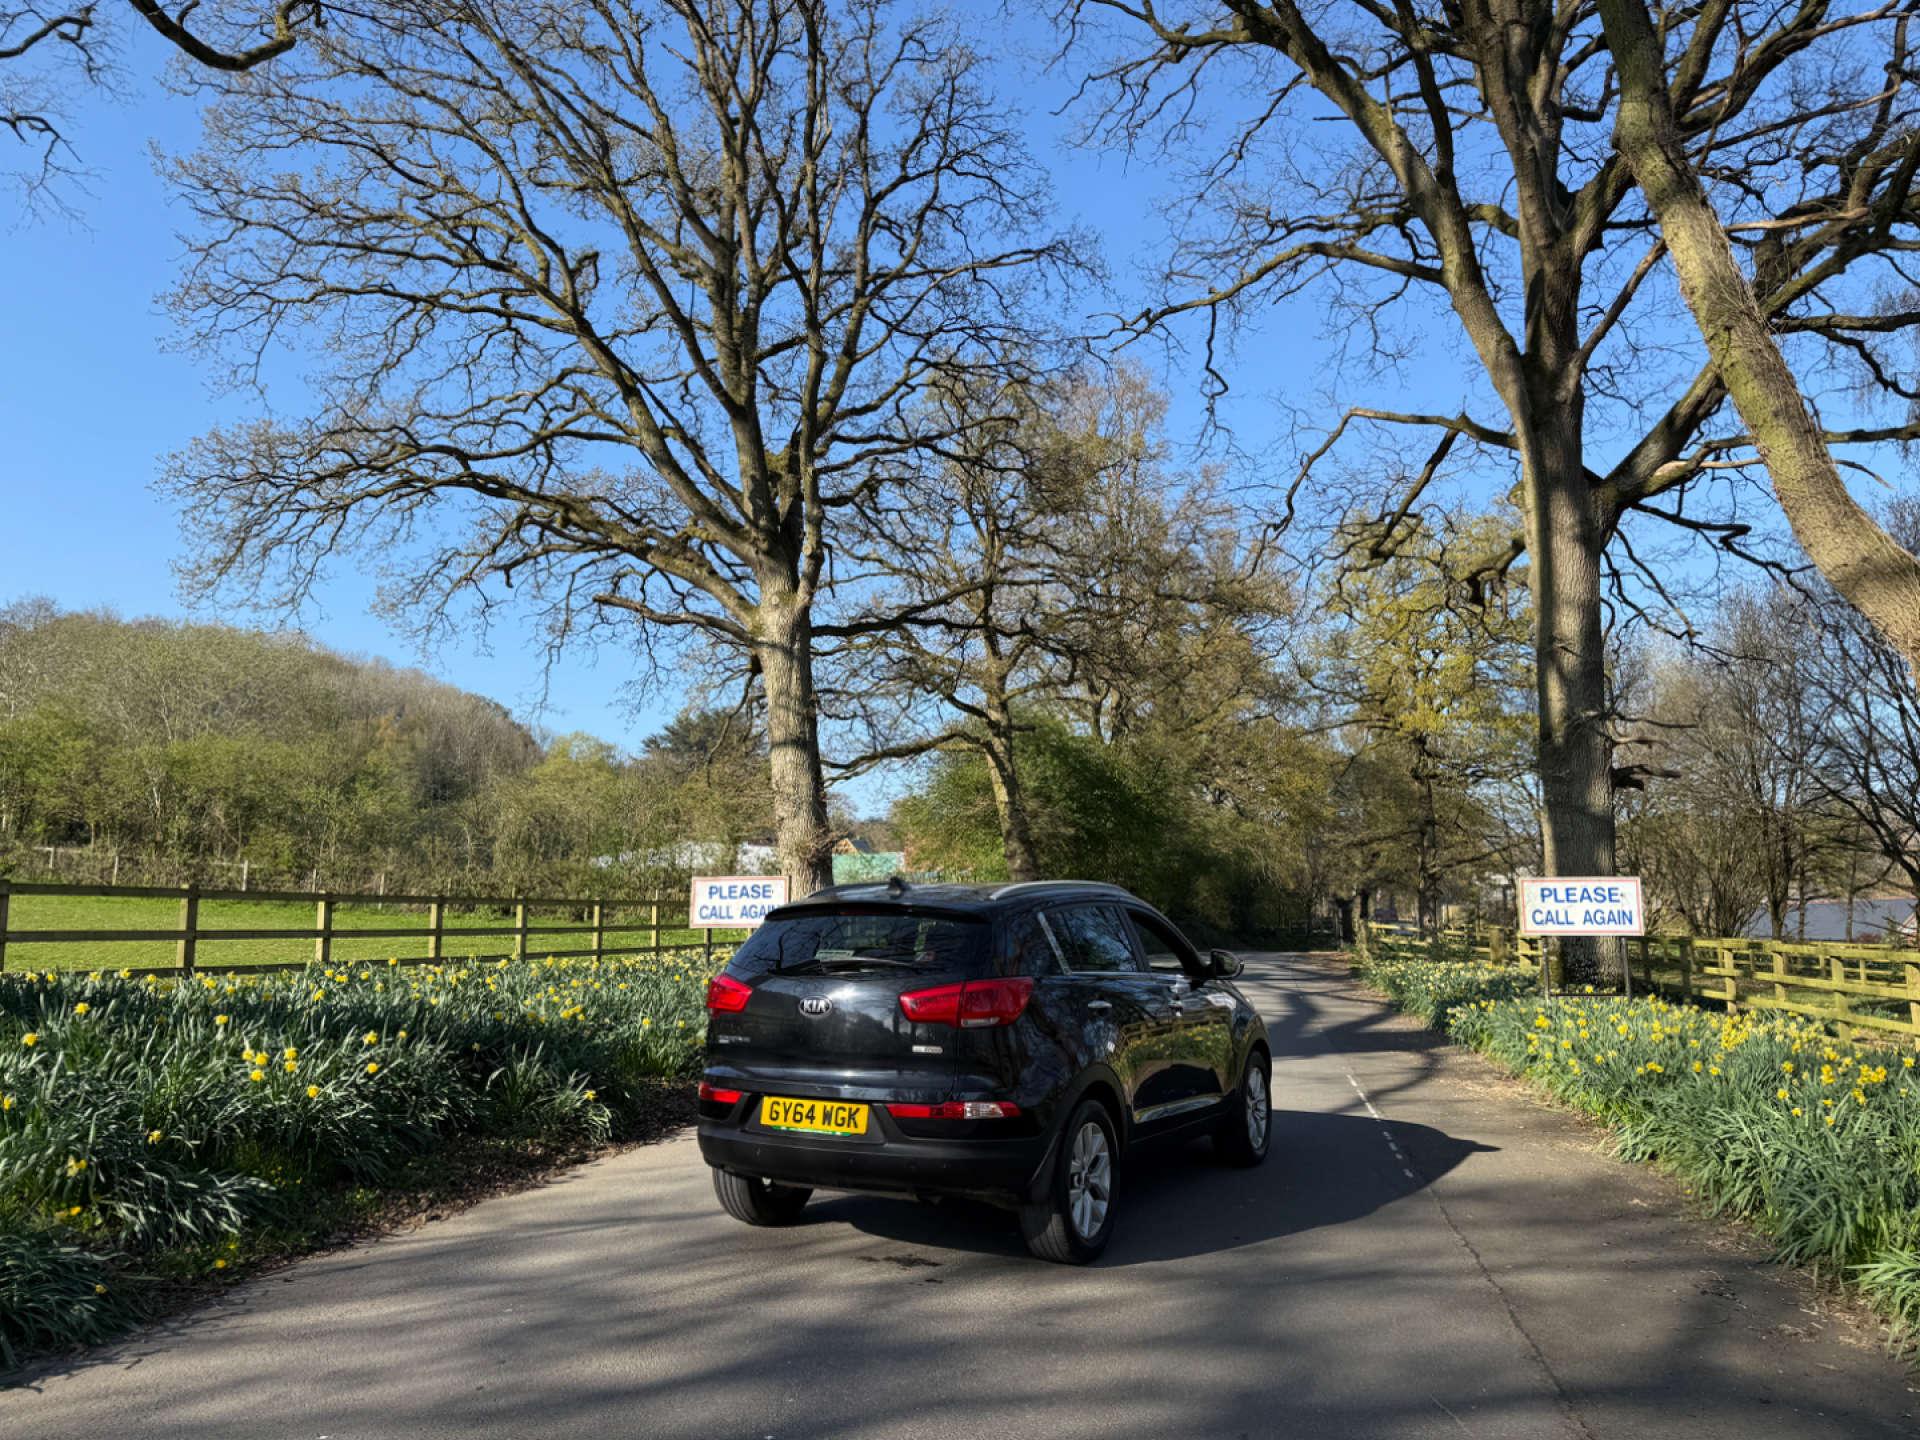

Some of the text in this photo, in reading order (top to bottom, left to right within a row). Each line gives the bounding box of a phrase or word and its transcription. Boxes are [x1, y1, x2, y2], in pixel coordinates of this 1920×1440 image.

[708, 884, 772, 900] PLEASE
[1540, 887, 1621, 904] PLEASE
[699, 904, 777, 920] CALL AGAI
[1531, 908, 1633, 926] CALL AGAIN
[803, 999, 828, 1013] KIA
[769, 1100, 860, 1129] GY64 WGK
